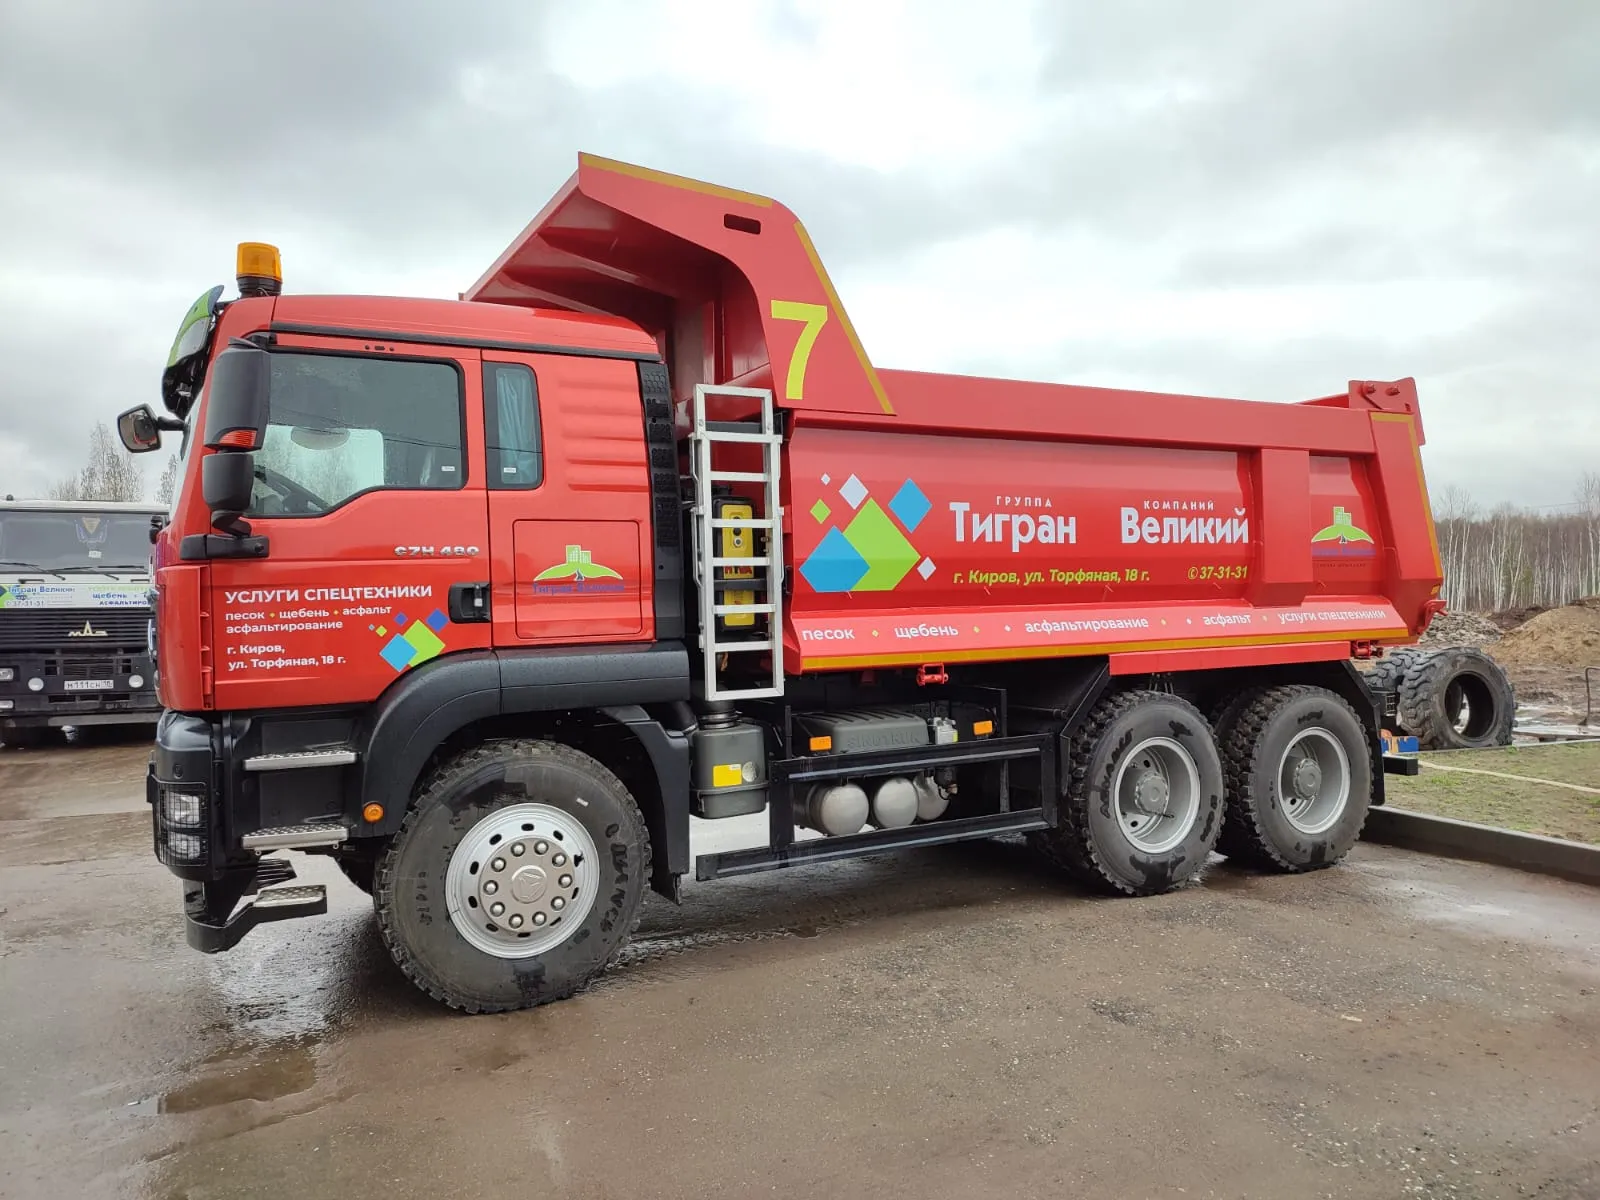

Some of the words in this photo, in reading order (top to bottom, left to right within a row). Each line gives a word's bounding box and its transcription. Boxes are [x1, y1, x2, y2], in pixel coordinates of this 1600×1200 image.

[771, 300, 828, 400] 7
[996, 496, 1052, 508] ГРУППА
[1144, 499, 1214, 511] КОМПАНИЙ
[950, 502, 1077, 552] Тигран
[1120, 506, 1249, 544] Великий
[440, 545, 480, 556] 480
[953, 573, 964, 584] г.
[968, 570, 1020, 585] Киров,
[1023, 571, 1045, 585] ул.
[1049, 568, 1121, 585] Торфяная,
[1125, 568, 1138, 581] 18
[1141, 570, 1150, 581] г.
[1199, 566, 1248, 580] 37-31-31
[225, 589, 299, 604] УСЛУГИ
[304, 585, 433, 602] СПЕЦТЕХНИКИ
[225, 610, 265, 622] песок
[279, 608, 329, 619] щебень
[342, 605, 392, 617] асфальт
[226, 620, 343, 634] асфальтирование
[802, 628, 855, 641] песок
[894, 623, 959, 639] щебень
[1025, 616, 1149, 635] асфальтирование
[1203, 611, 1251, 628] асфальт
[1278, 609, 1317, 624] услуги
[1317, 609, 1386, 623] спецтехники
[227, 646, 237, 655] г.
[239, 643, 285, 656] Киров,
[228, 660, 248, 671] ул.
[250, 656, 319, 669] Торфяная,
[321, 655, 334, 665] 18
[336, 656, 346, 665] г.
